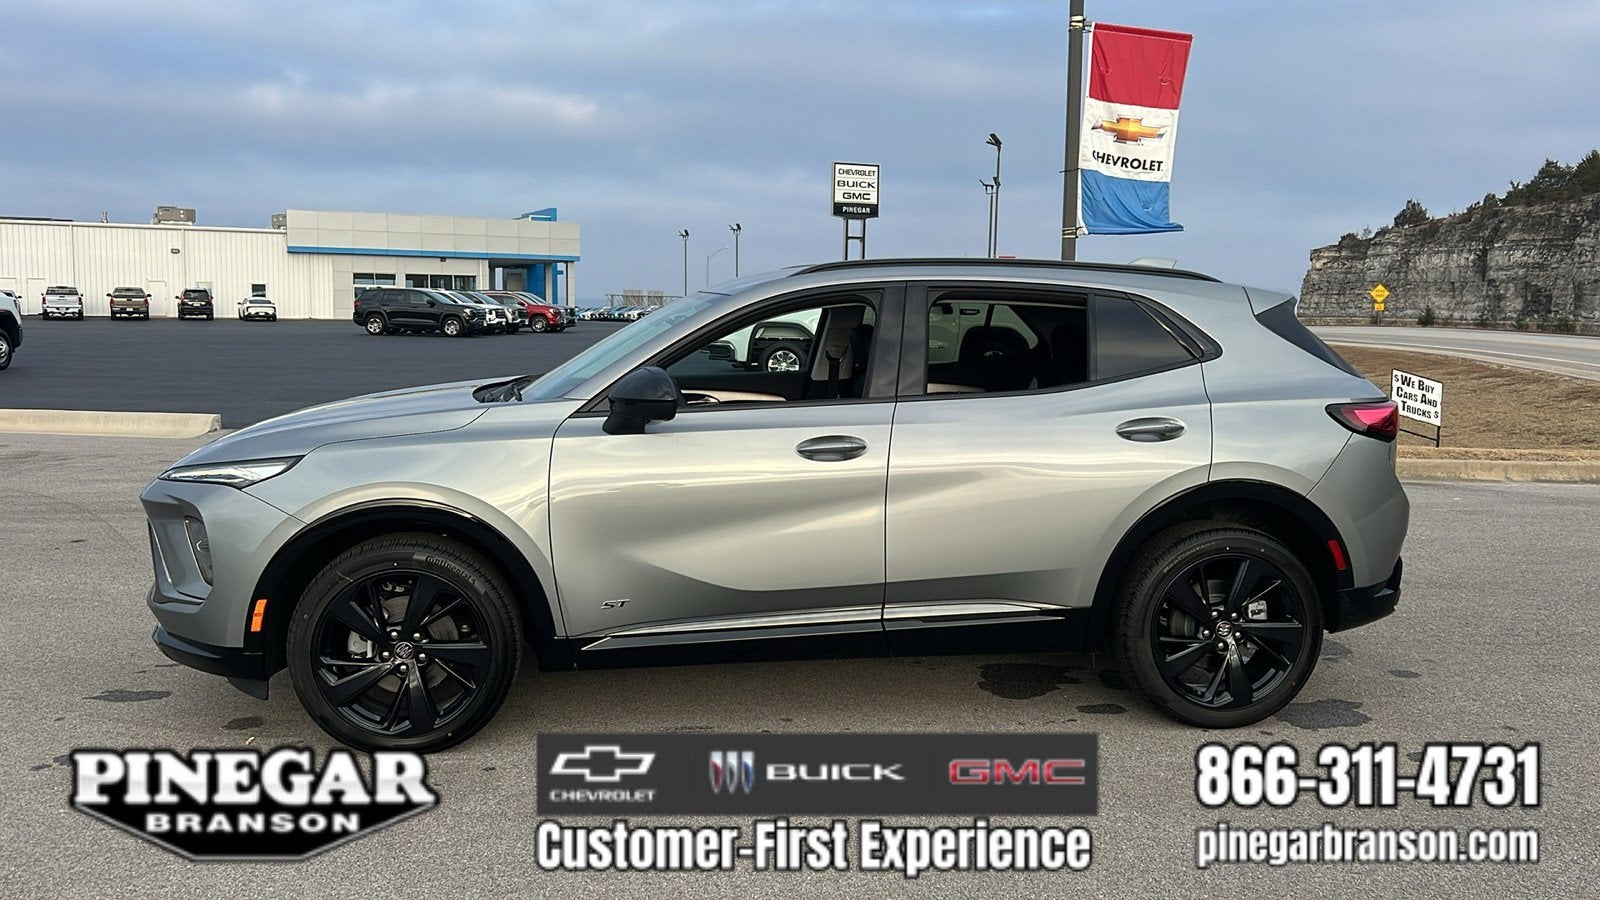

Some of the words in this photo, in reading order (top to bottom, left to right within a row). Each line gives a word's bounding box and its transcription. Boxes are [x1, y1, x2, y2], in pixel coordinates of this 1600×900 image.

[838, 168, 876, 177] CHEVROLET
[837, 180, 876, 189] BUICK
[842, 192, 871, 200] GMC
[842, 206, 871, 214] PINEGAR
[601, 599, 630, 609] ST
